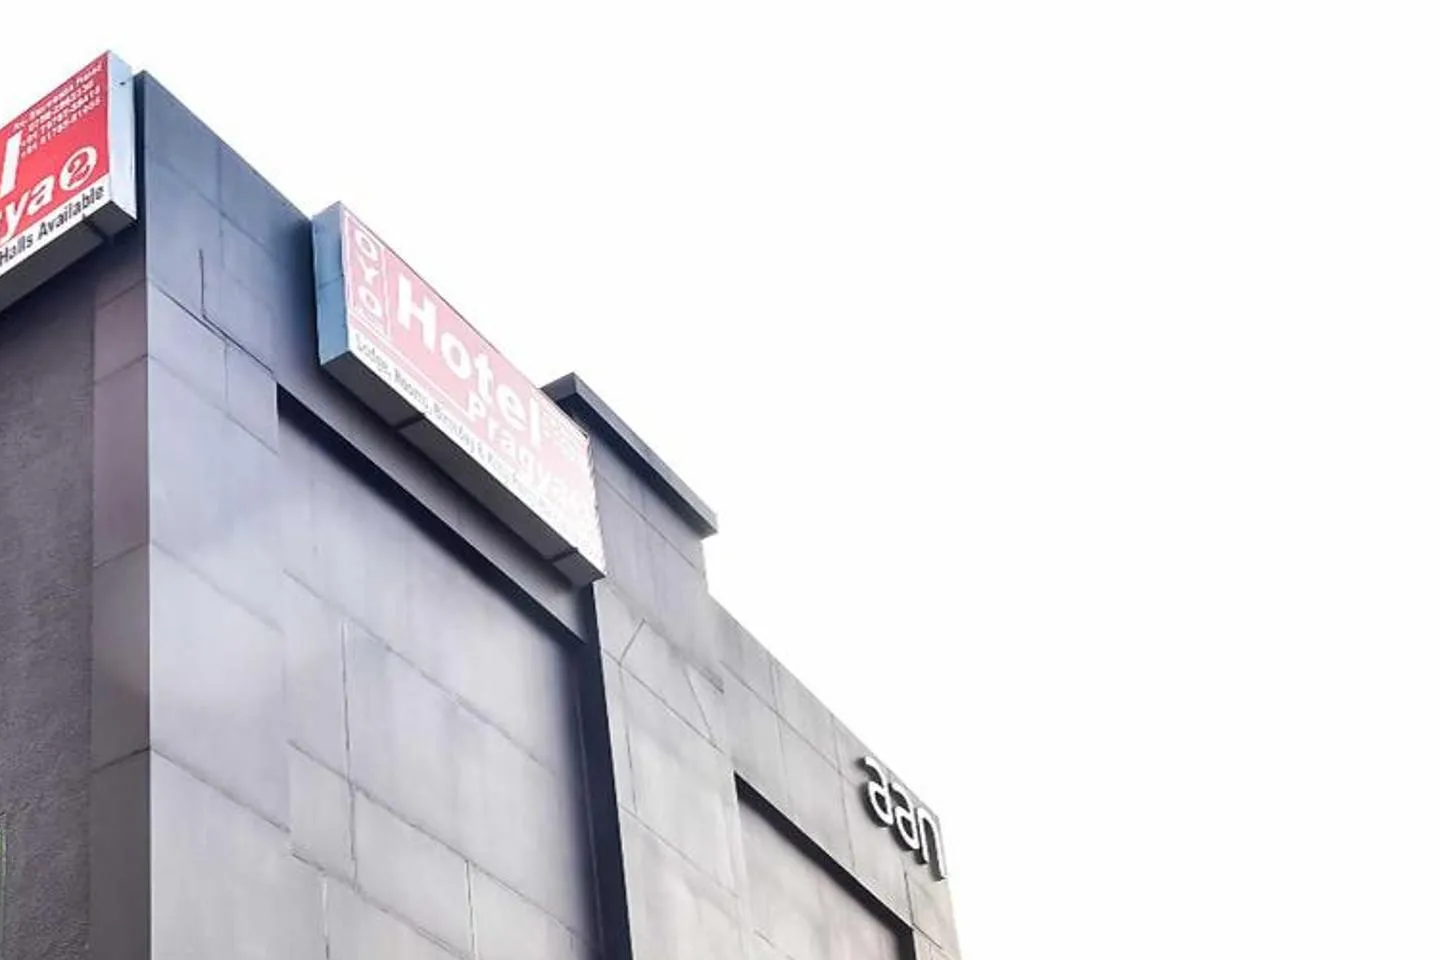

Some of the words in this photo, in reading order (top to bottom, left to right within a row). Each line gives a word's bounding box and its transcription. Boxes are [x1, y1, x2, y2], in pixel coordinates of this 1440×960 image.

[0, 233, 34, 267] Halls
[37, 185, 105, 240] Available
[355, 228, 381, 319] OYO
[397, 274, 541, 446] Hotel
[860, 756, 946, 880] aan
